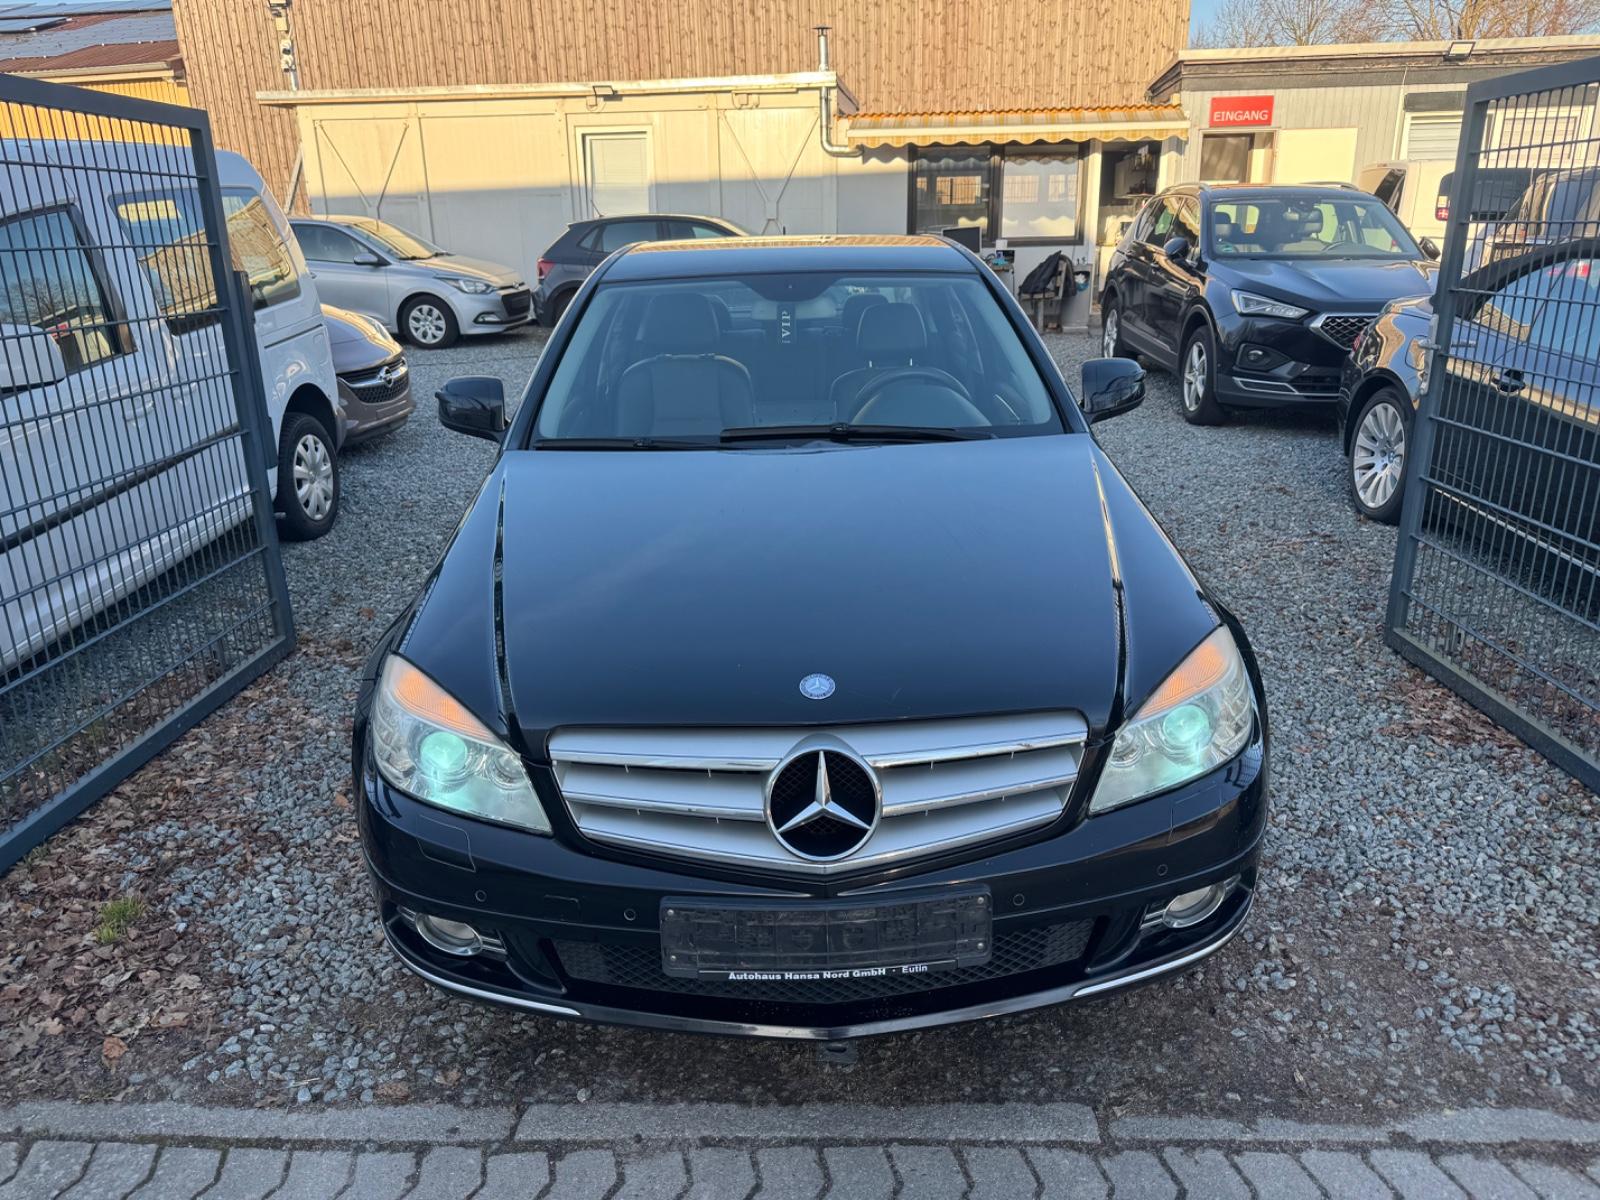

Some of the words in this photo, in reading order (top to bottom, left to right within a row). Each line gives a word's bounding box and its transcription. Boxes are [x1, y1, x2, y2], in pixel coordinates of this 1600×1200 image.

[1213, 109, 1269, 122] EINGANG
[728, 971, 782, 980] Autohaus
[784, 972, 820, 980] Hansa
[822, 970, 850, 979] Nord
[852, 967, 886, 977] GmbH
[901, 964, 928, 974] Eutin
